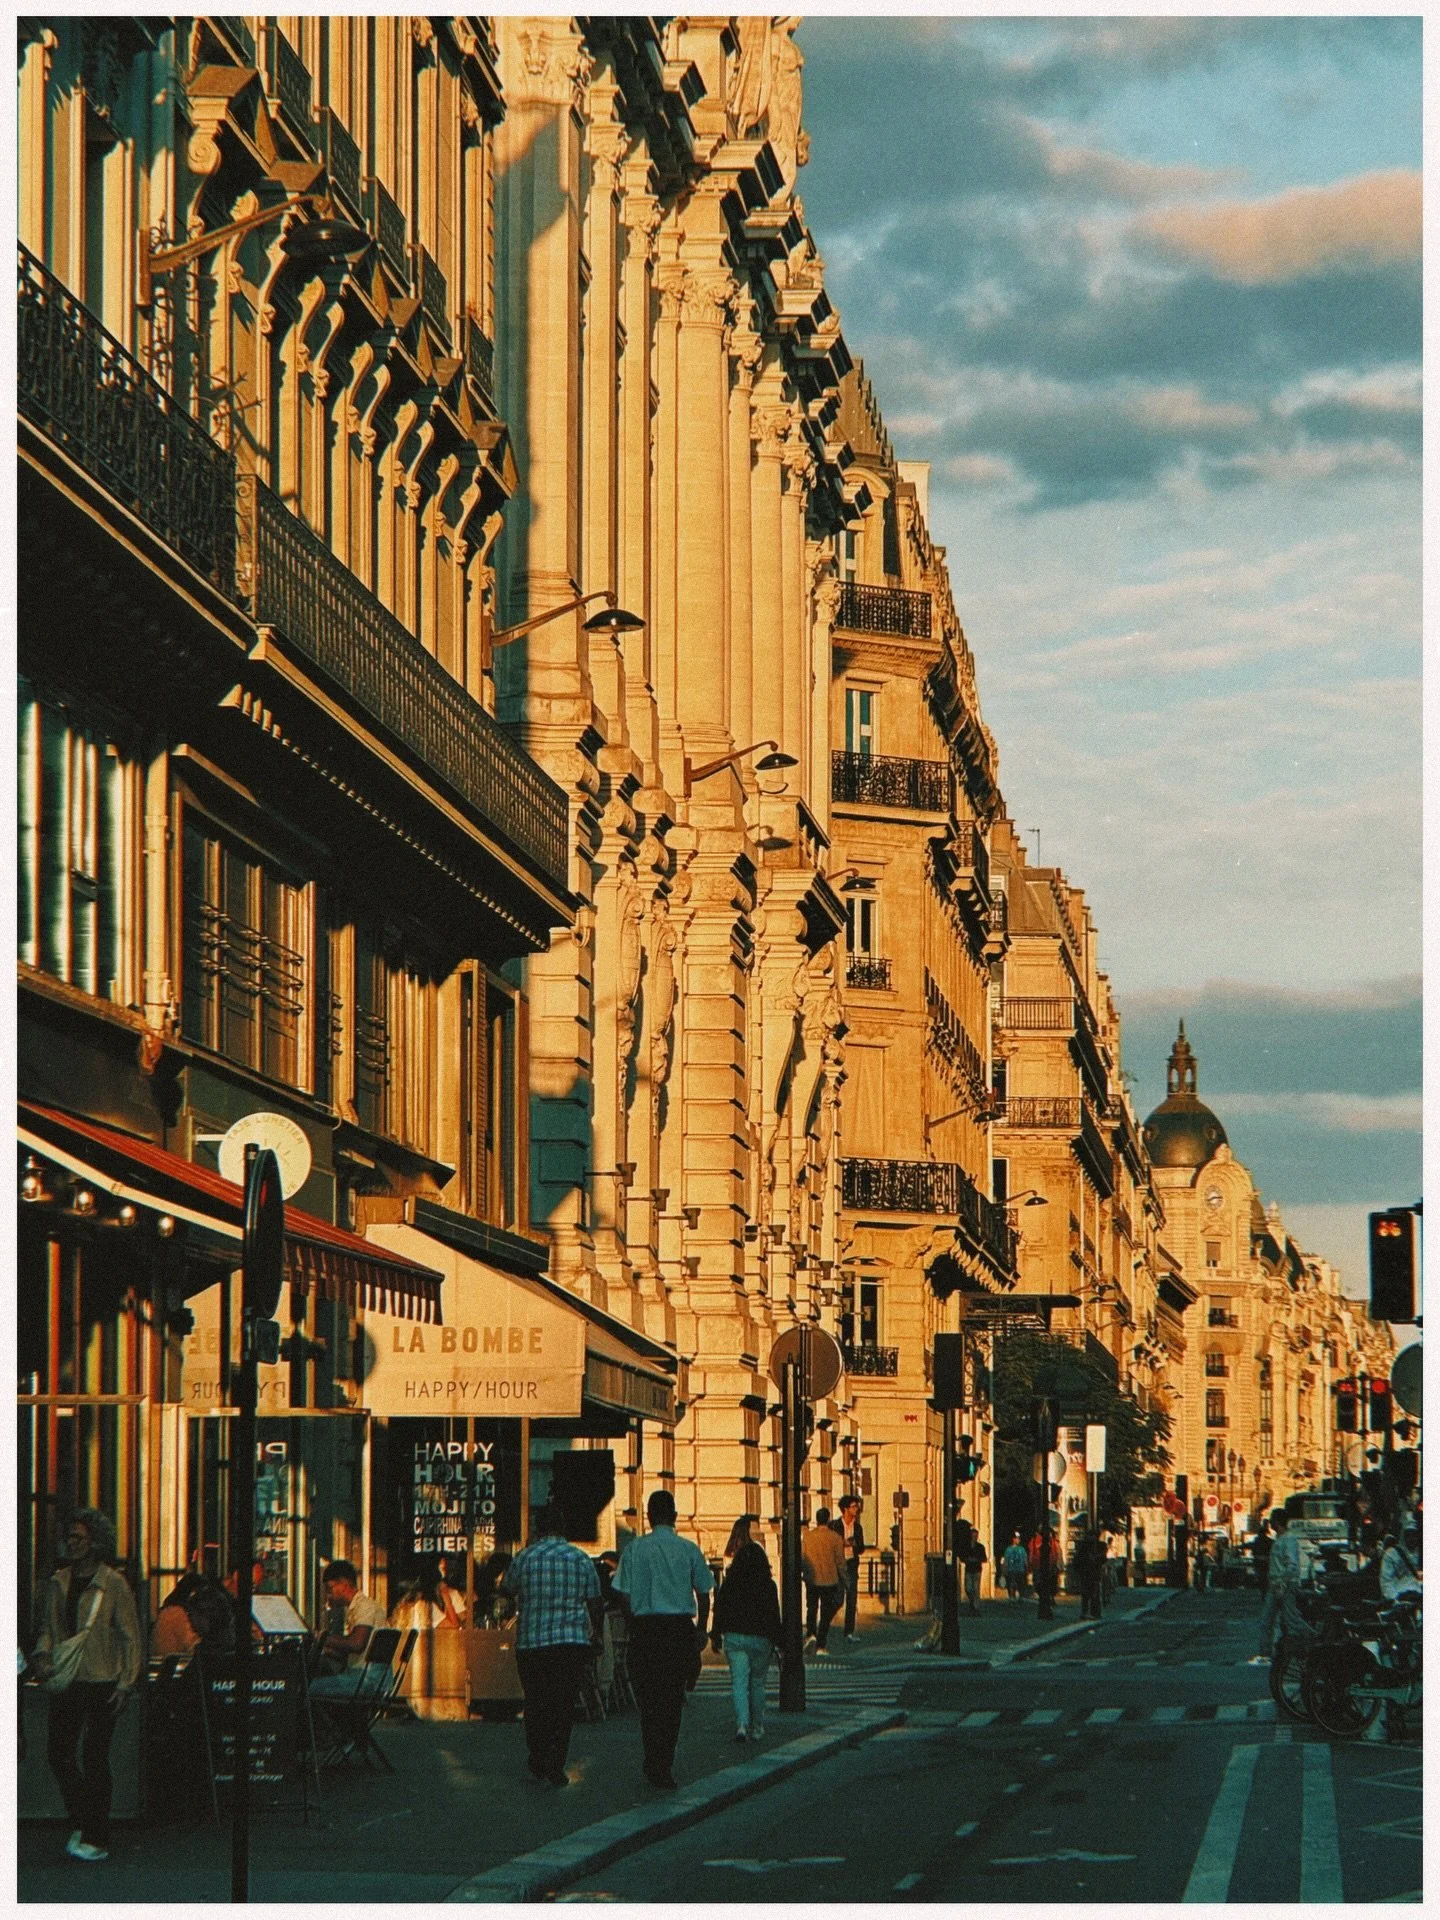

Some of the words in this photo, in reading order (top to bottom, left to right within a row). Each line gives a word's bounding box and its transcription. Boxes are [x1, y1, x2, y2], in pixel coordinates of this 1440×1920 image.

[392, 1326, 425, 1353] LA
[441, 1326, 543, 1354] BOMBE
[405, 1380, 538, 1400] HAPPY/HOUR
[414, 1442, 494, 1461] HAPPY
[212, 1681, 237, 1691] HAP
[251, 1680, 286, 1691] HOUR
